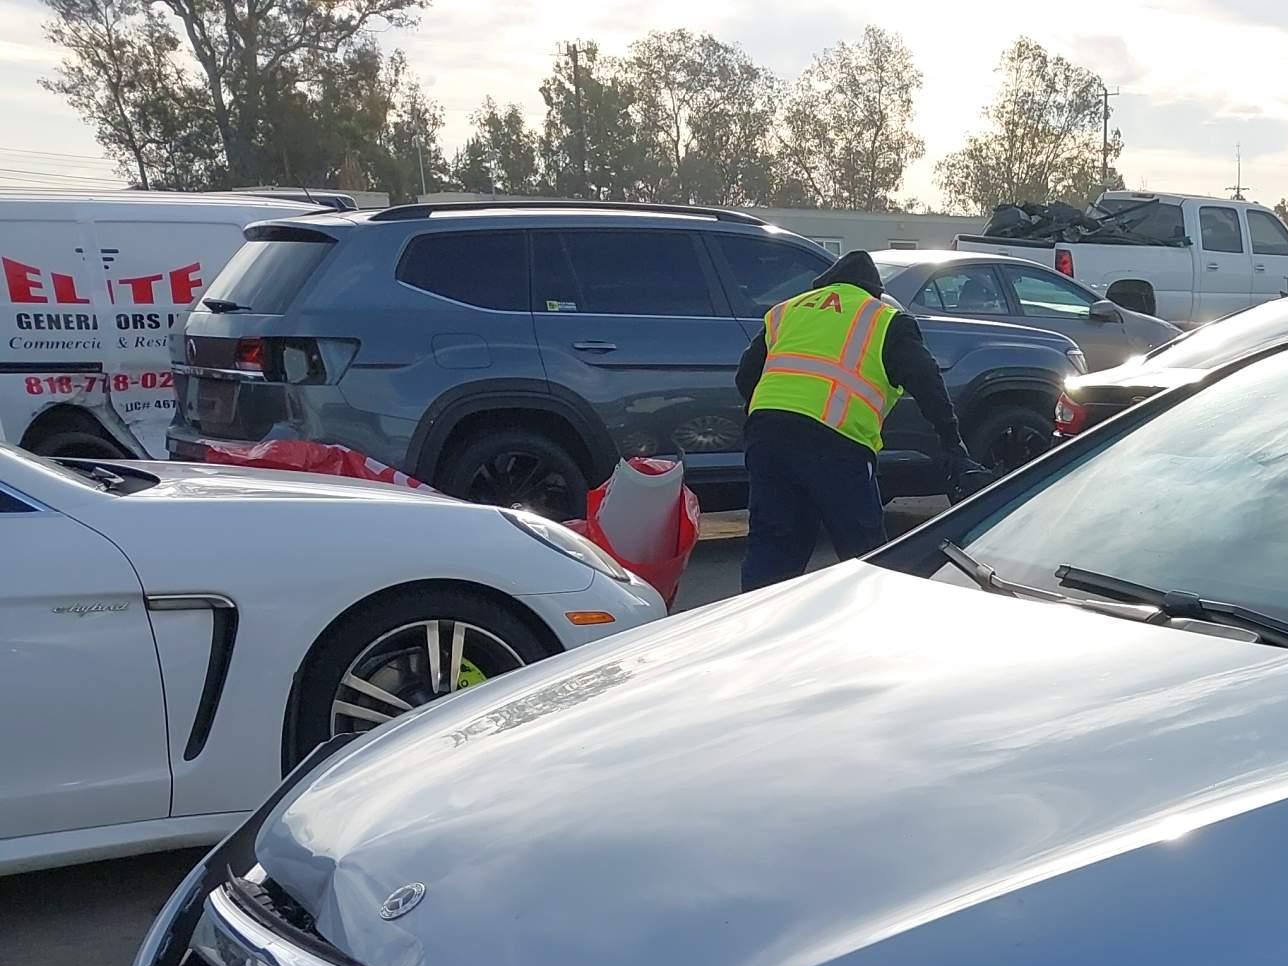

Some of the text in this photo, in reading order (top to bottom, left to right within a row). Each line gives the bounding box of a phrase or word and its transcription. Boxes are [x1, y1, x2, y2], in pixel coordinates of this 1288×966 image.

[2, 256, 203, 305] ELTE
[16, 312, 161, 331] GENERORS
[9, 336, 104, 350] Commerci
[117, 336, 129, 349] &
